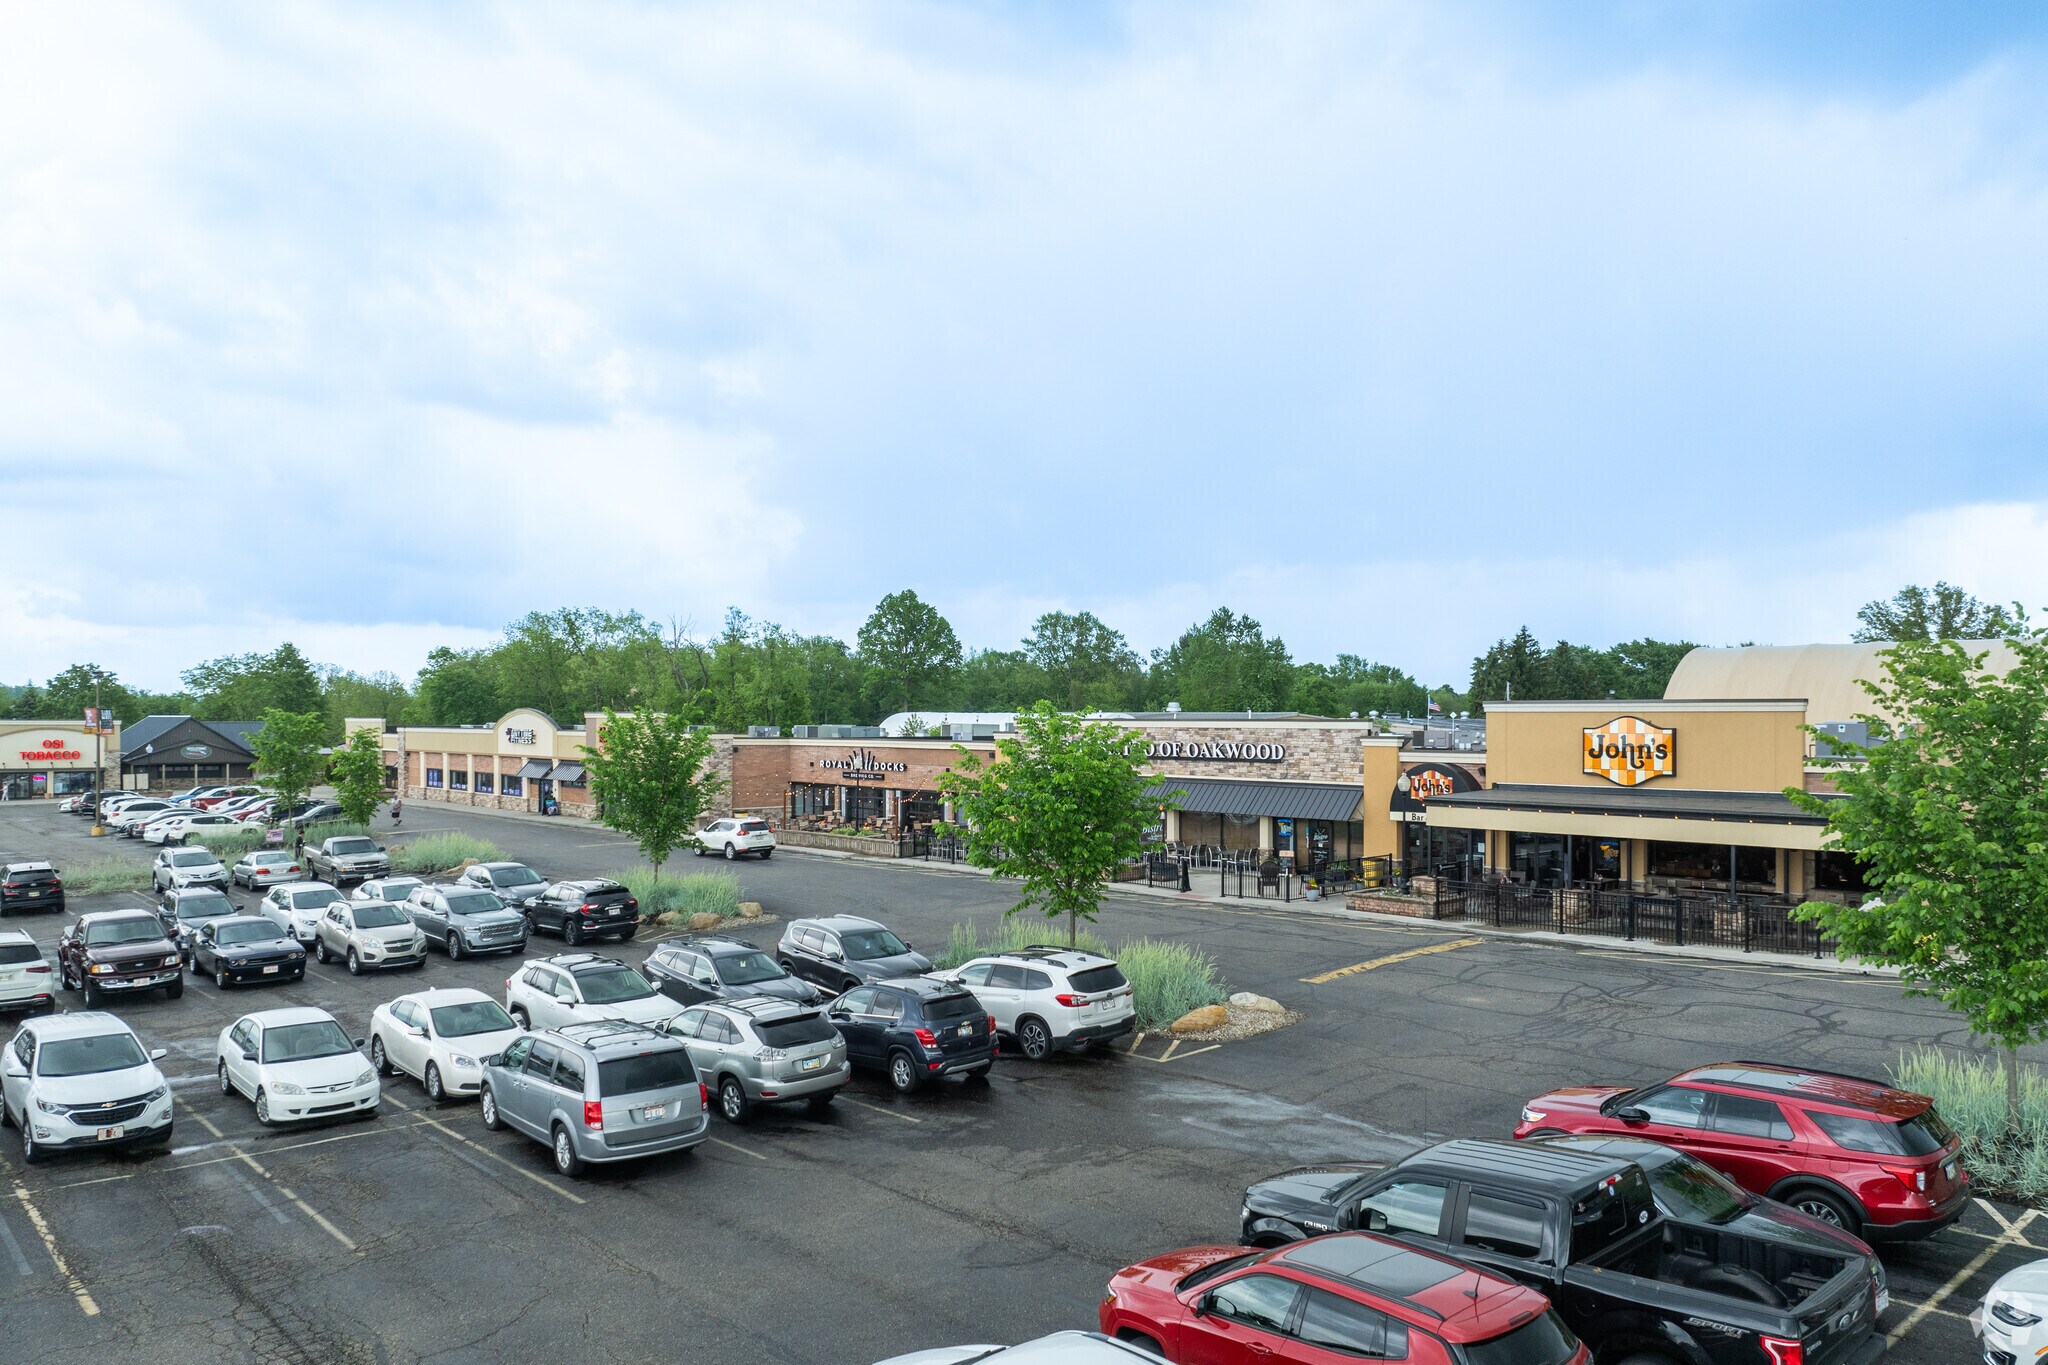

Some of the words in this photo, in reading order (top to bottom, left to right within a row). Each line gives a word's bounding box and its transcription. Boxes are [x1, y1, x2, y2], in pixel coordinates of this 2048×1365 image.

[42, 739, 64, 749] OSI
[510, 736, 533, 745] FITNESS
[19, 750, 81, 760] TOBACCO
[1159, 742, 1183, 758] OF
[1186, 742, 1285, 761] OAKWOOD
[1588, 734, 1668, 770] John's
[819, 760, 848, 769] ROYAL
[873, 762, 905, 772] DOCKS
[1413, 778, 1451, 796] John's
[1411, 813, 1424, 821] Bar
[1683, 1317, 1750, 1337] SPORT
